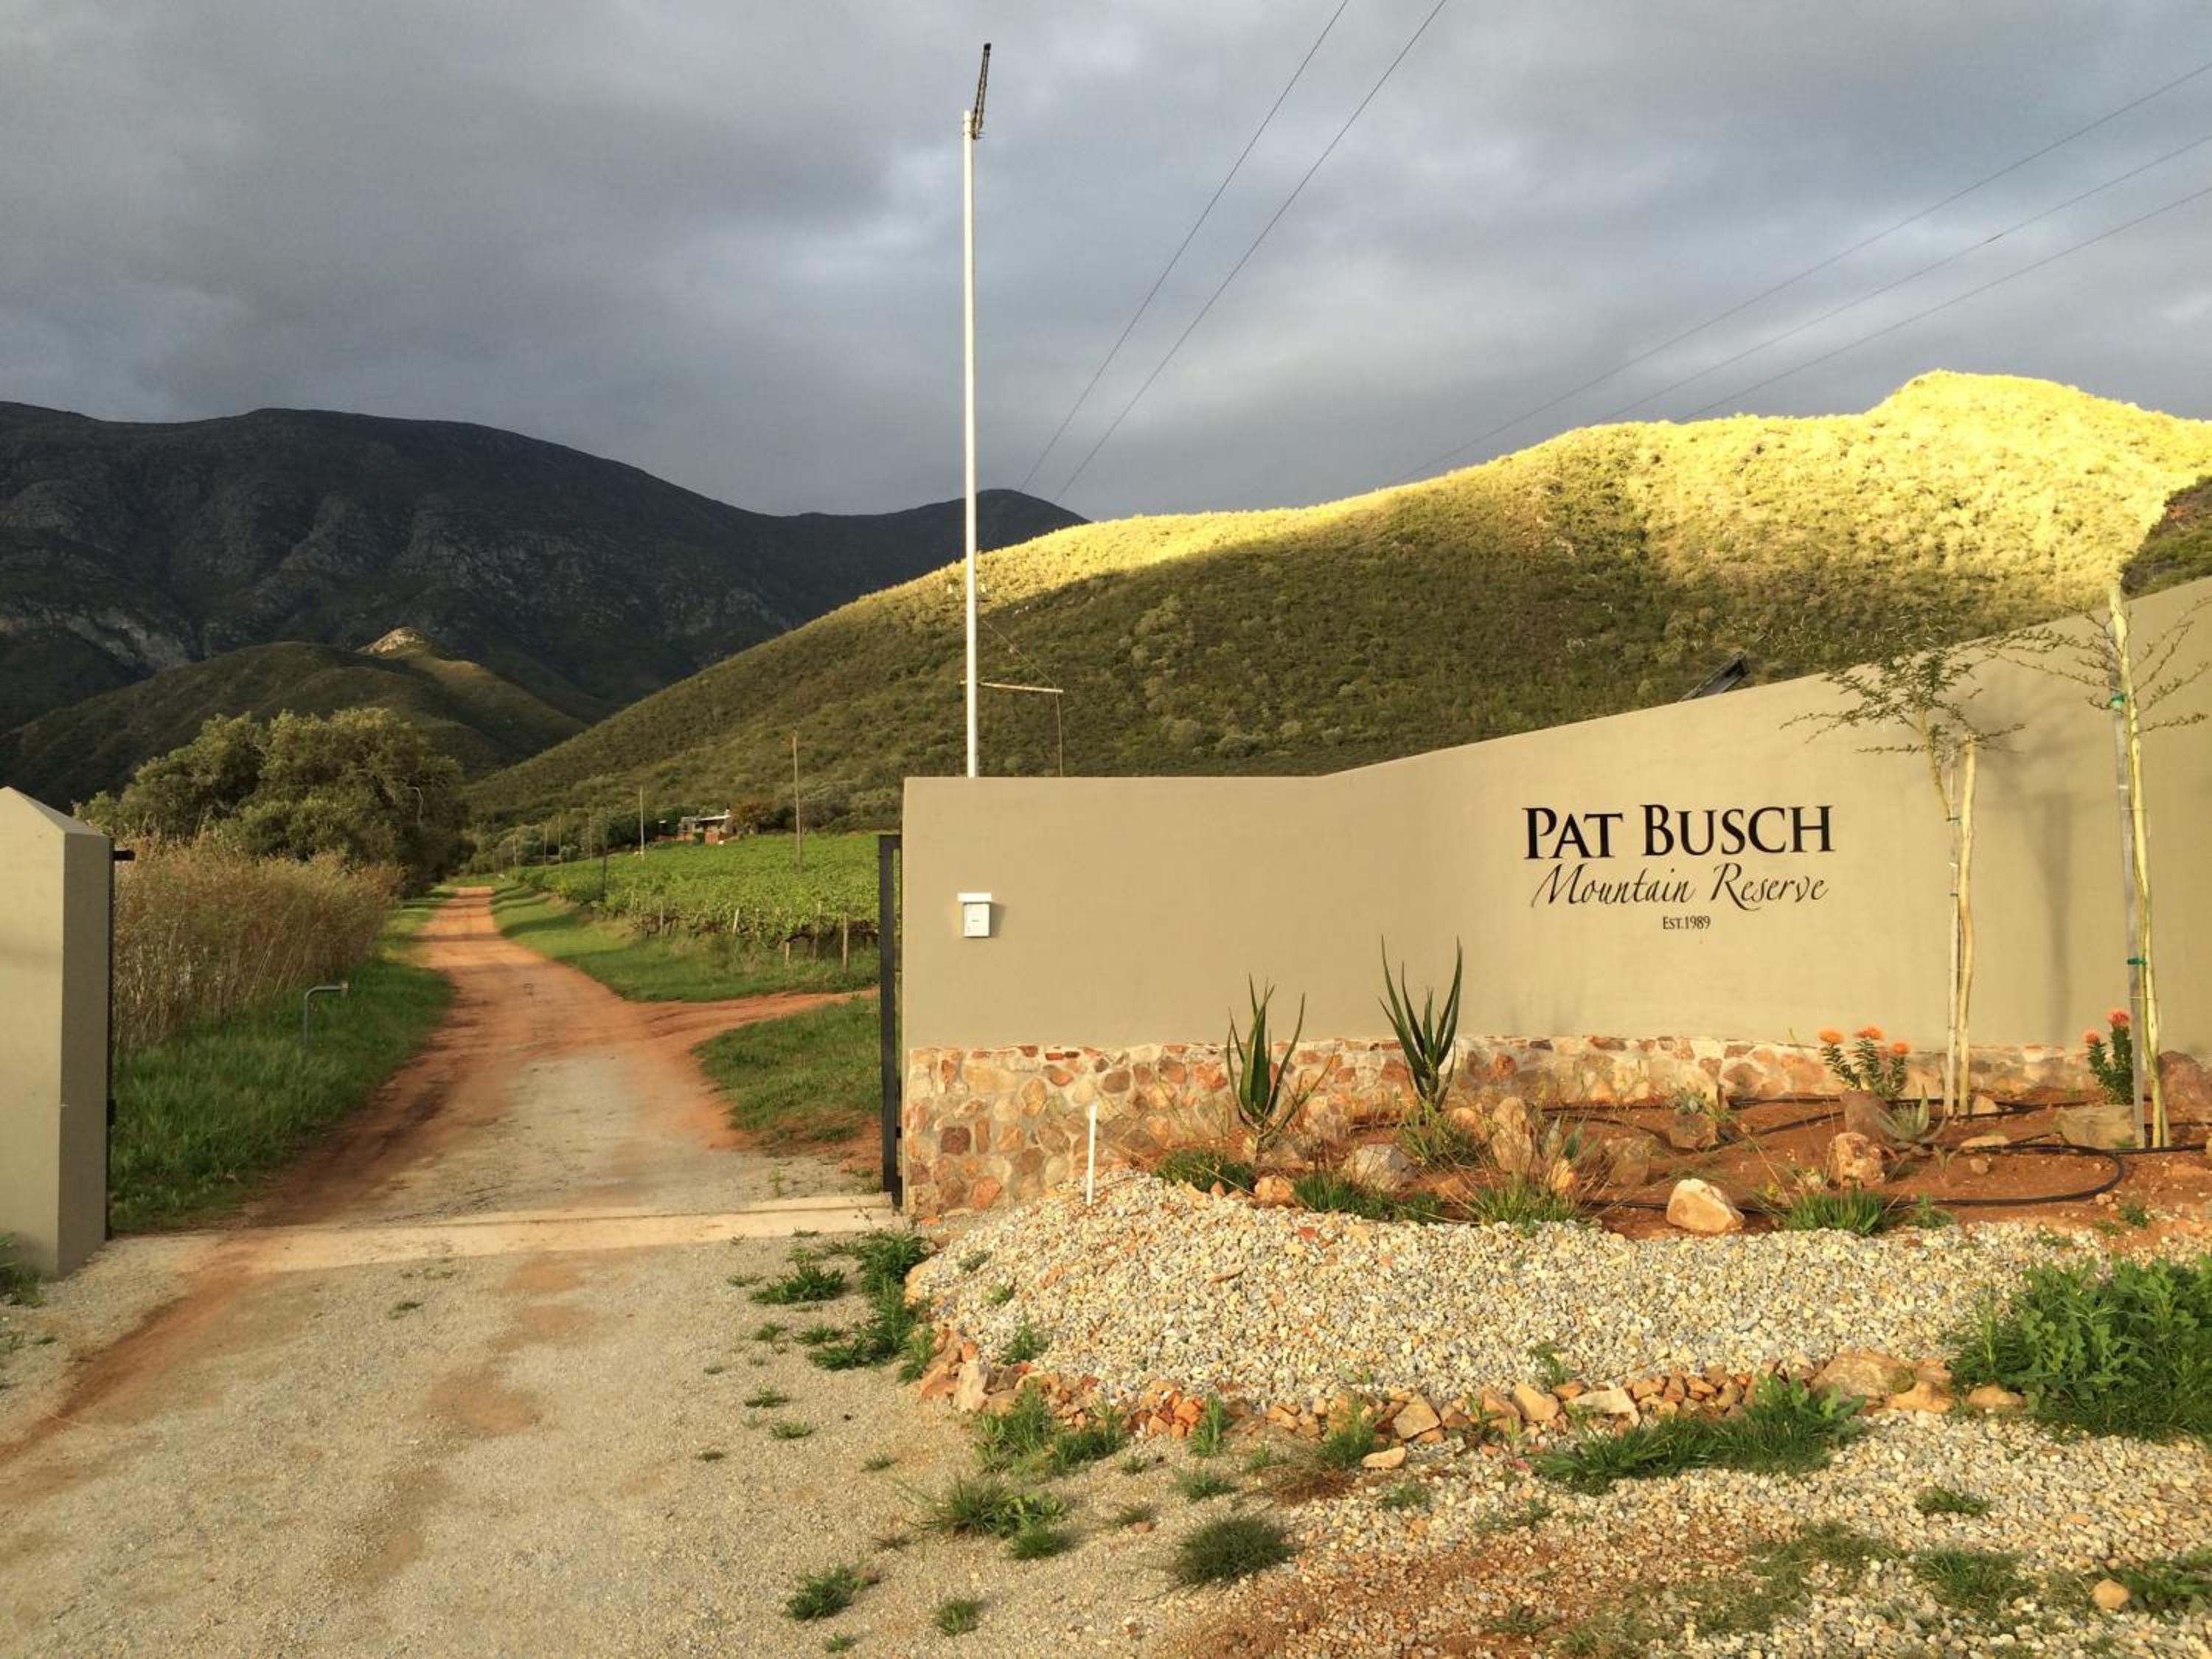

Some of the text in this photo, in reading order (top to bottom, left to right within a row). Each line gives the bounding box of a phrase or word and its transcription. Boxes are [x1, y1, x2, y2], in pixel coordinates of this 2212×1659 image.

[1521, 804, 1836, 860] PAT BUSCH
[1531, 862, 1829, 911] Mountain Reserve
